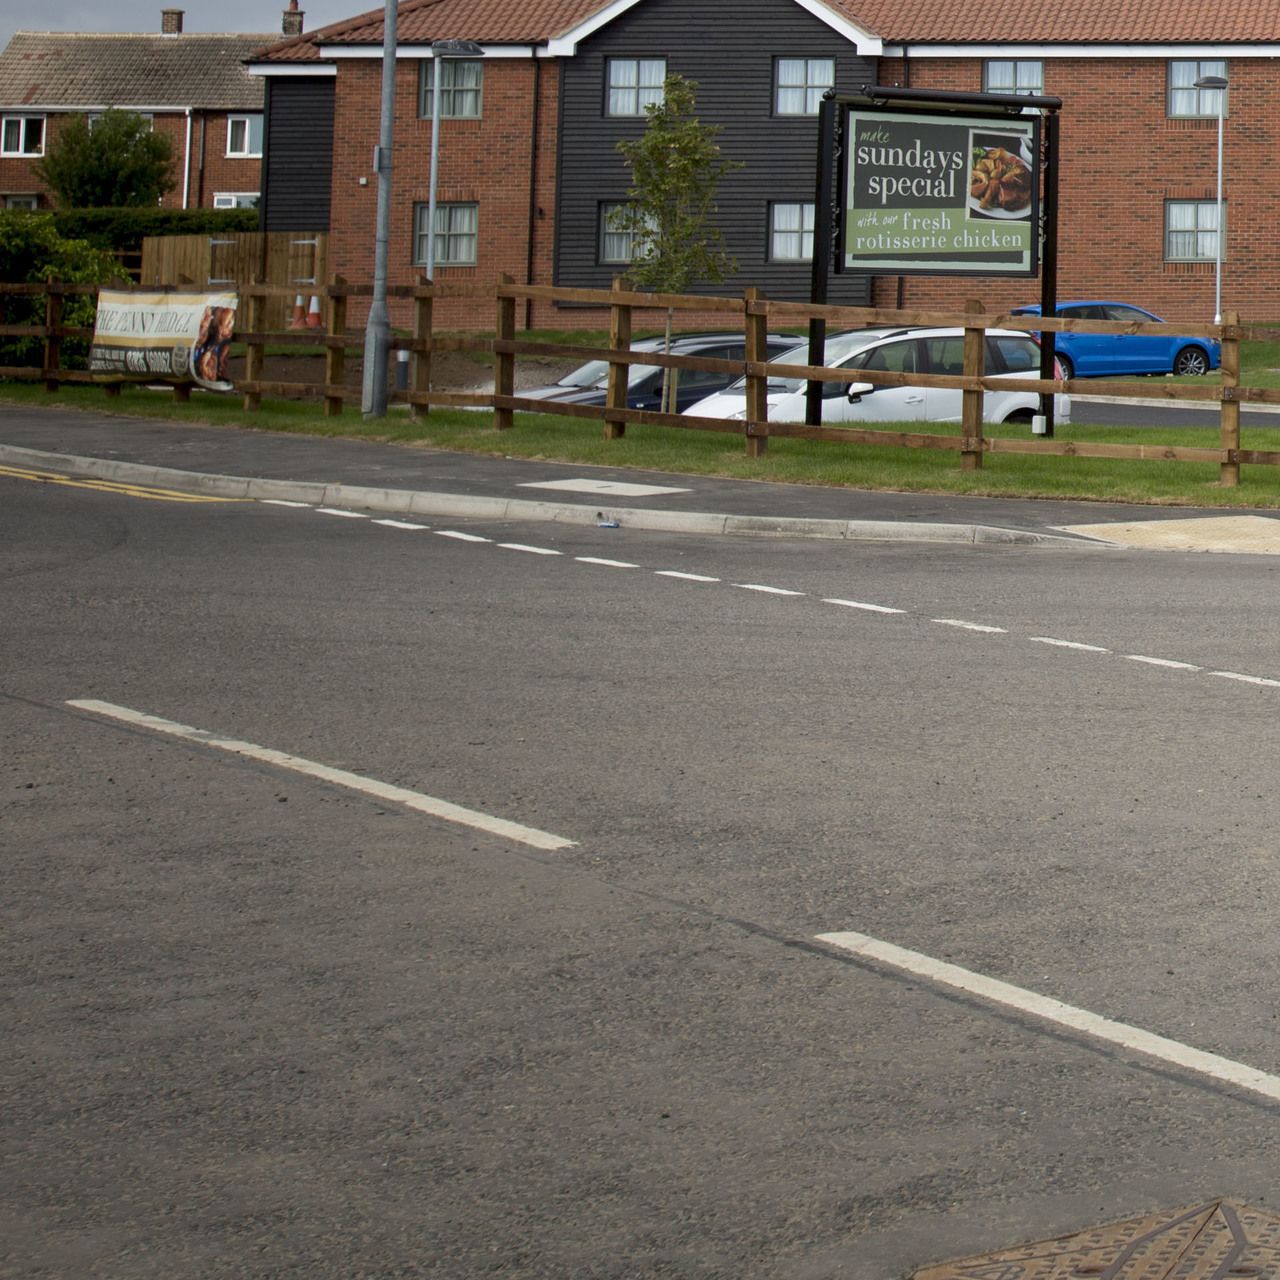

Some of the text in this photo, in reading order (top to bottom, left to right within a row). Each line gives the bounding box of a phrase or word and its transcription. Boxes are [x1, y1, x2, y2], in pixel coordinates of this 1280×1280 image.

[860, 125, 890, 143] make
[857, 139, 963, 177] sundays
[868, 169, 955, 205] special
[857, 212, 879, 227] with
[903, 212, 951, 230] fresh
[856, 229, 1022, 249] rotisserie chicken
